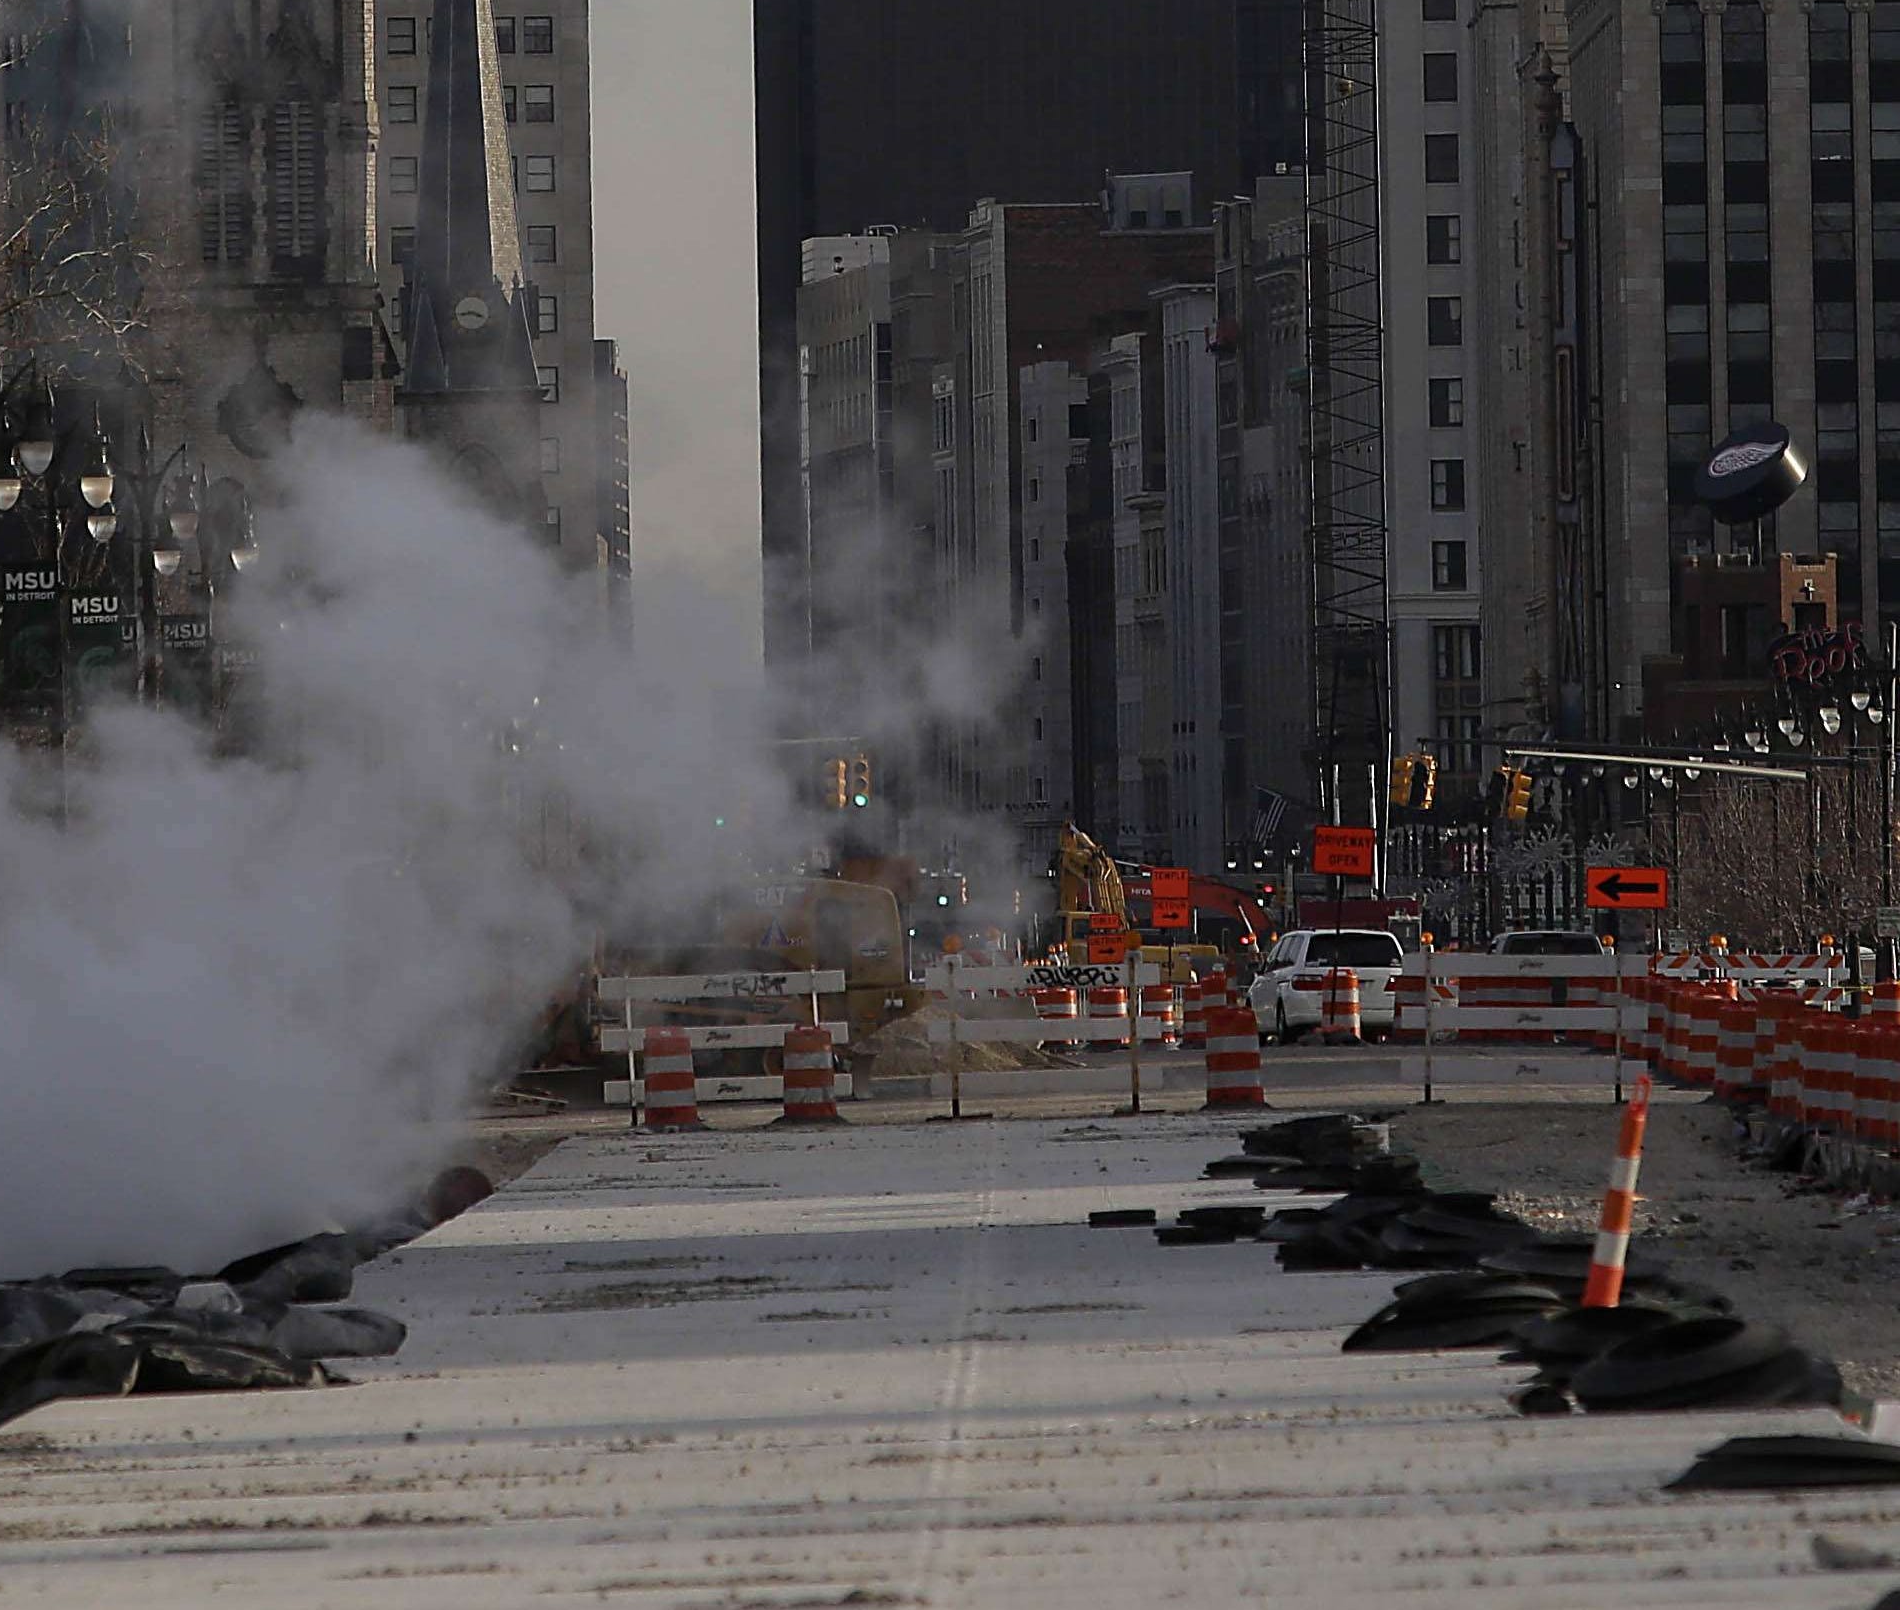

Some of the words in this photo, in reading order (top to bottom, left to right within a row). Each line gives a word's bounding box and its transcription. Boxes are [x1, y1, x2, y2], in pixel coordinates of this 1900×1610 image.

[5, 572, 55, 590] MSU
[18, 591, 56, 601] DETROIT
[71, 596, 119, 615] MSU
[83, 615, 119, 625] DETROIT
[1317, 834, 1373, 849] DRIVEWAY
[1329, 854, 1359, 867] OPEN
[1154, 871, 1186, 881] TEMPLE
